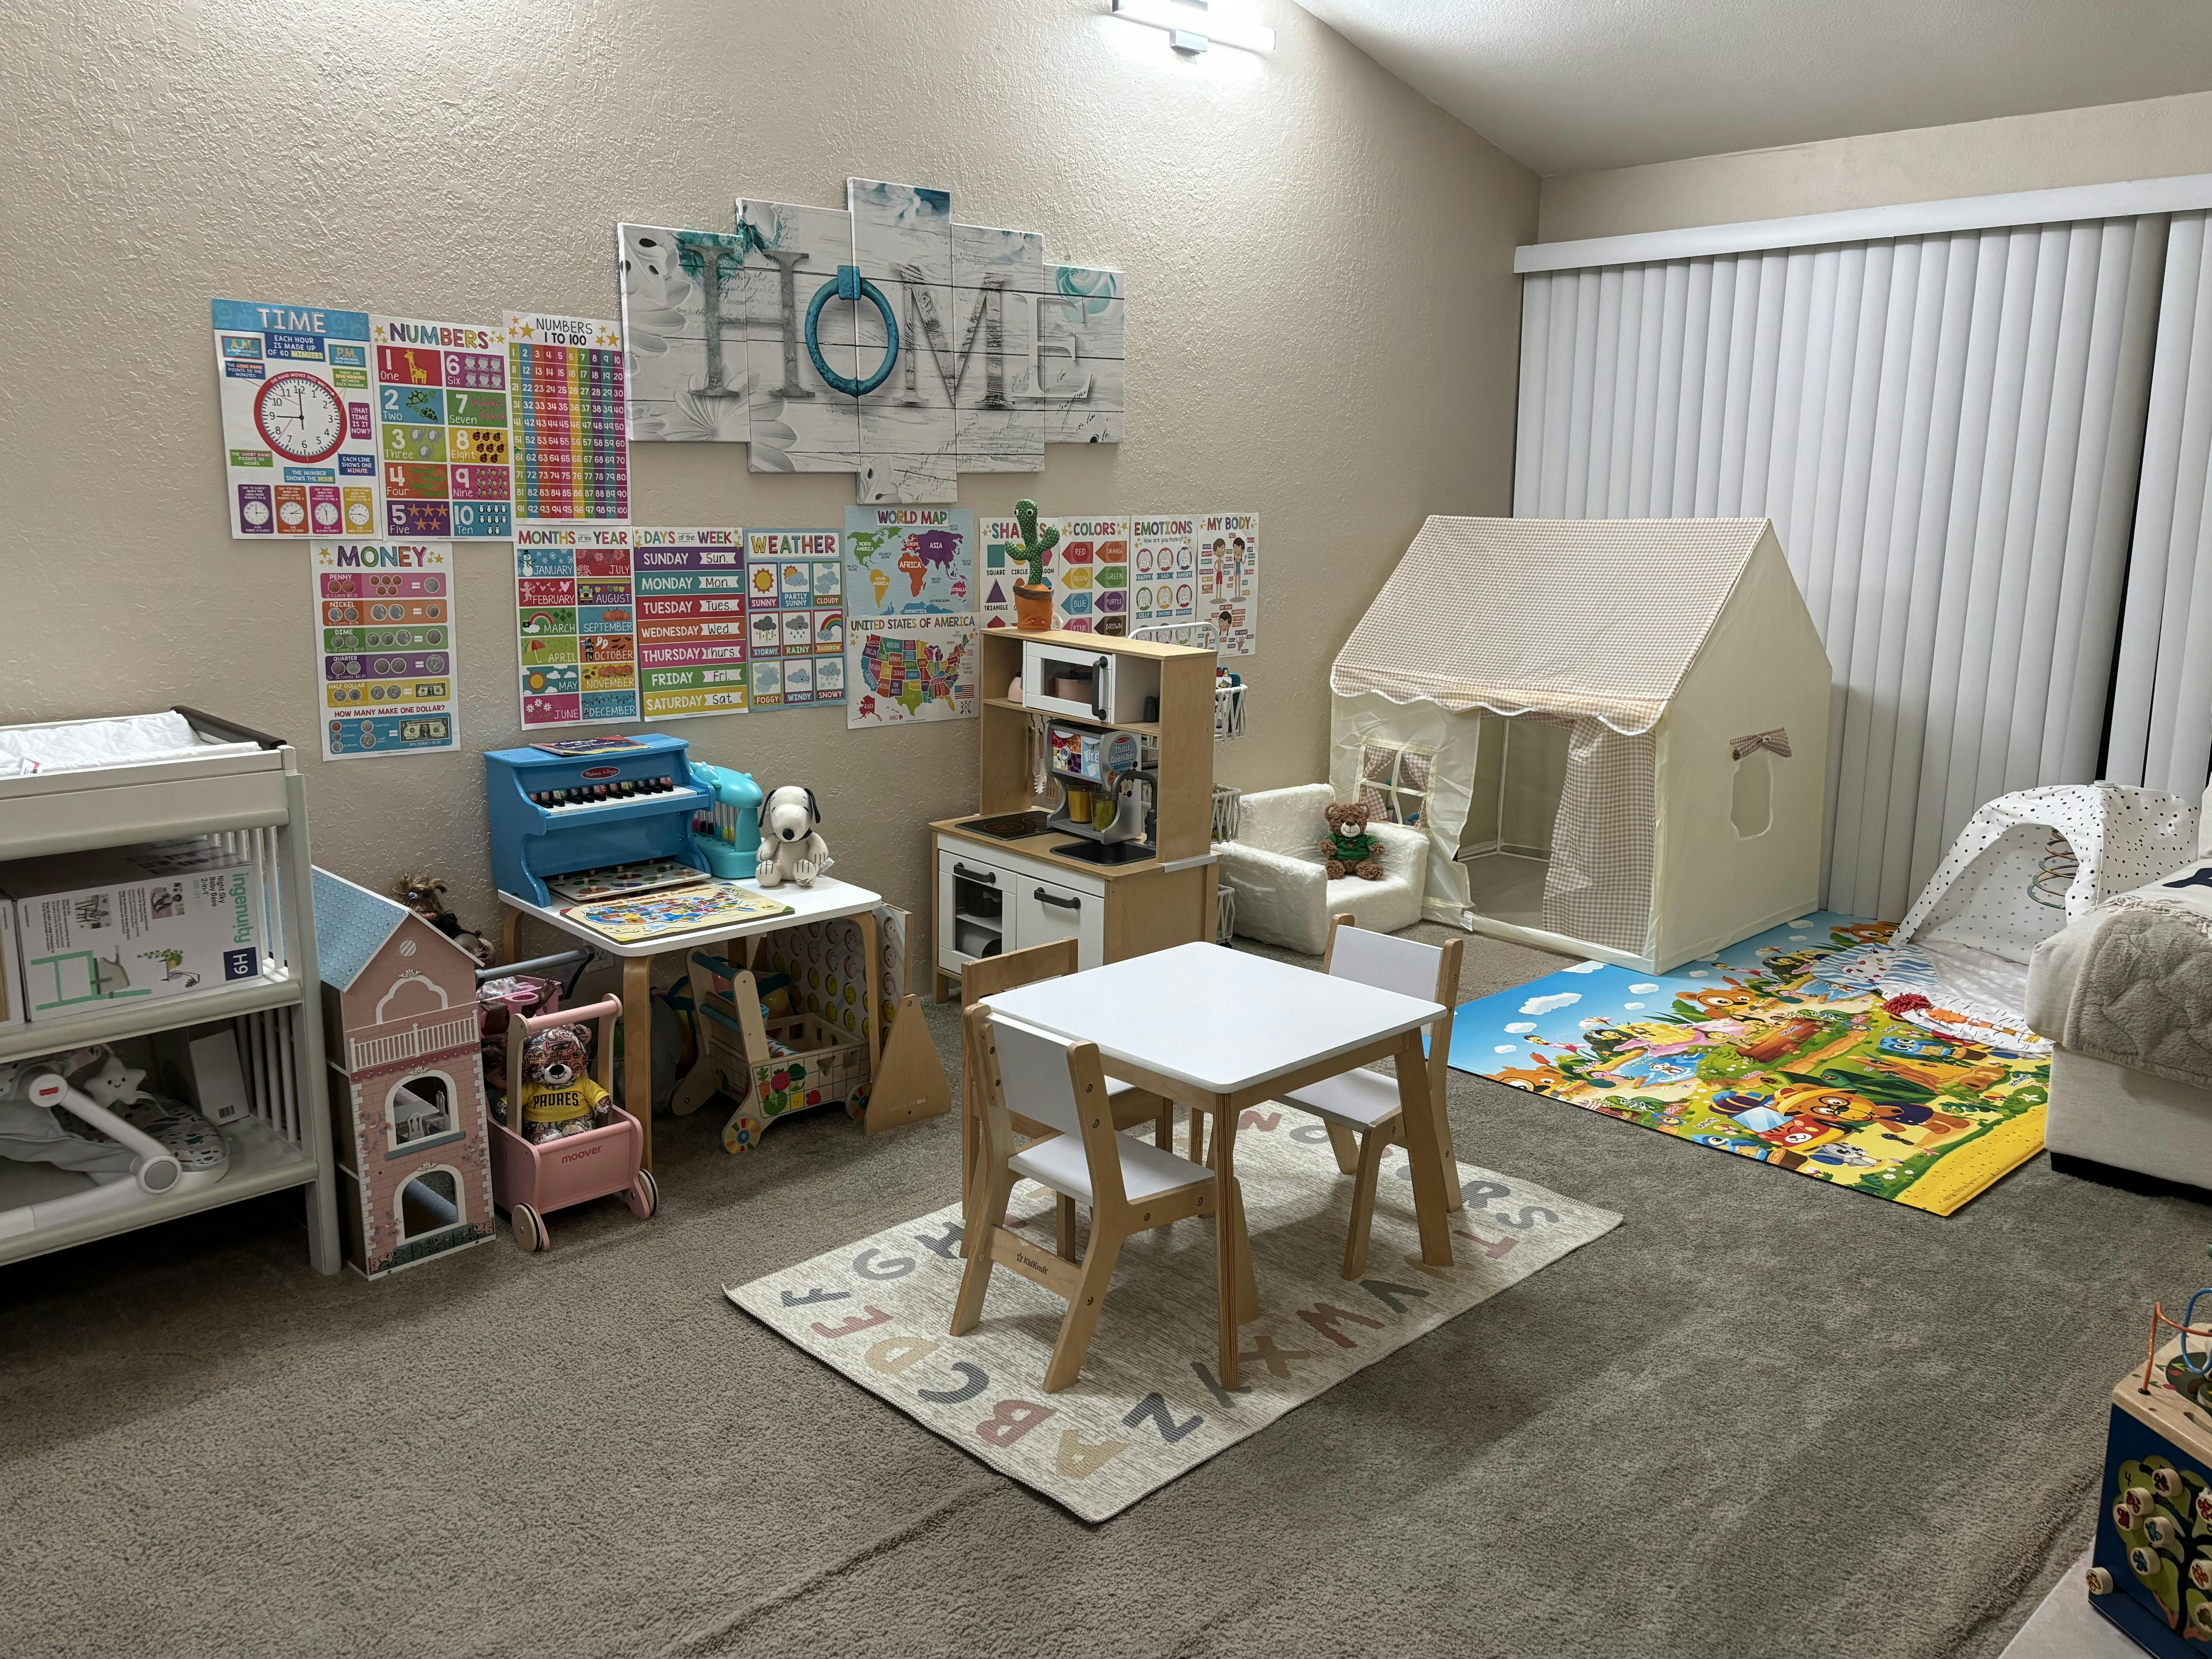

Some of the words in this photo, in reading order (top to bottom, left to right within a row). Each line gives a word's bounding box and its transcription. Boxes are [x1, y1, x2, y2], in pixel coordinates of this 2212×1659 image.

[257, 307, 327, 334] TIME
[536, 318, 592, 334] NUMBERS
[685, 244, 1092, 409] HOME
[390, 323, 489, 349] NUMBERS
[544, 331, 548, 342] 1
[551, 333, 565, 344] TO
[569, 334, 587, 345] 100
[291, 351, 323, 359] MINUTES
[386, 349, 392, 370] 1
[446, 355, 460, 375] 6
[381, 371, 399, 381] One
[384, 389, 399, 410] 2
[456, 394, 468, 414] 7
[383, 411, 402, 421] Two
[449, 415, 477, 424] Seven
[392, 429, 405, 449] 3
[457, 430, 469, 450] 8
[384, 449, 414, 459] Three
[390, 466, 405, 486] 4
[455, 468, 469, 488] 9
[387, 486, 409, 496] Four
[392, 505, 406, 525] 5
[454, 505, 474, 525] 10
[877, 510, 917, 524] WORLD
[921, 511, 947, 524] MAP
[457, 526, 473, 534] Ten
[992, 522, 1046, 539] SHAS
[1074, 522, 1116, 536] COLORS
[1134, 521, 1193, 536] EMOTIONS
[1207, 517, 1222, 531] MY
[1225, 517, 1251, 530] BODY
[519, 530, 576, 544] MONTHS
[593, 531, 628, 545] YEAR
[644, 531, 675, 544] DAYS
[697, 531, 732, 544] WEEK
[751, 535, 835, 554] WEATHER
[337, 545, 427, 567] MONEY
[643, 553, 689, 565] SUNDAY
[706, 553, 729, 563] Sun.
[533, 565, 573, 575] JANUARY
[609, 565, 630, 574] JULY
[642, 577, 693, 590] MONDAY
[706, 577, 730, 587] Mon.
[532, 595, 574, 605] FEBRUARY
[596, 594, 630, 603] AUGUST
[752, 599, 776, 607] SUNNY
[643, 601, 692, 614] TUESDAY
[706, 601, 732, 611] Tues.
[544, 624, 575, 634] MARCH
[584, 622, 632, 632] SEPTEMBER
[708, 624, 732, 635] Wed.
[851, 620, 884, 631] UNITED
[888, 618, 917, 629] STATES
[919, 618, 931, 628] OF
[934, 617, 975, 627] AMERICA
[641, 625, 699, 638] WEDNESDAY
[548, 653, 577, 663] APRIL
[595, 650, 633, 660] OCTOBER
[643, 647, 700, 662] THURSDAY
[704, 648, 737, 658] Thurs.
[559, 681, 577, 690] MAY
[587, 678, 634, 689] NOVEMBER
[652, 672, 693, 686] FRIDAY
[646, 695, 702, 711] SATURDAY
[757, 696, 779, 704] FOGGY
[554, 709, 579, 720] JUNE
[590, 707, 635, 717] DECEMBER
[1115, 744, 1130, 754] Thirst
[1088, 751, 1099, 763] ICE
[1110, 753, 1135, 763] Quencher
[229, 872, 253, 943] ingenuity
[233, 953, 248, 974] H9
[533, 1092, 579, 1108] PADRES
[561, 1146, 602, 1164] moover
[853, 1248, 916, 1280] G
[1023, 1256, 1049, 1275] KidKraft
[780, 1288, 851, 1307] F
[811, 1305, 893, 1338] E
[864, 1336, 941, 1375] D
[916, 1360, 990, 1408] C
[974, 1399, 1057, 1449] B
[1121, 1392, 1204, 1443] Z
[1055, 1428, 1130, 1480] A
